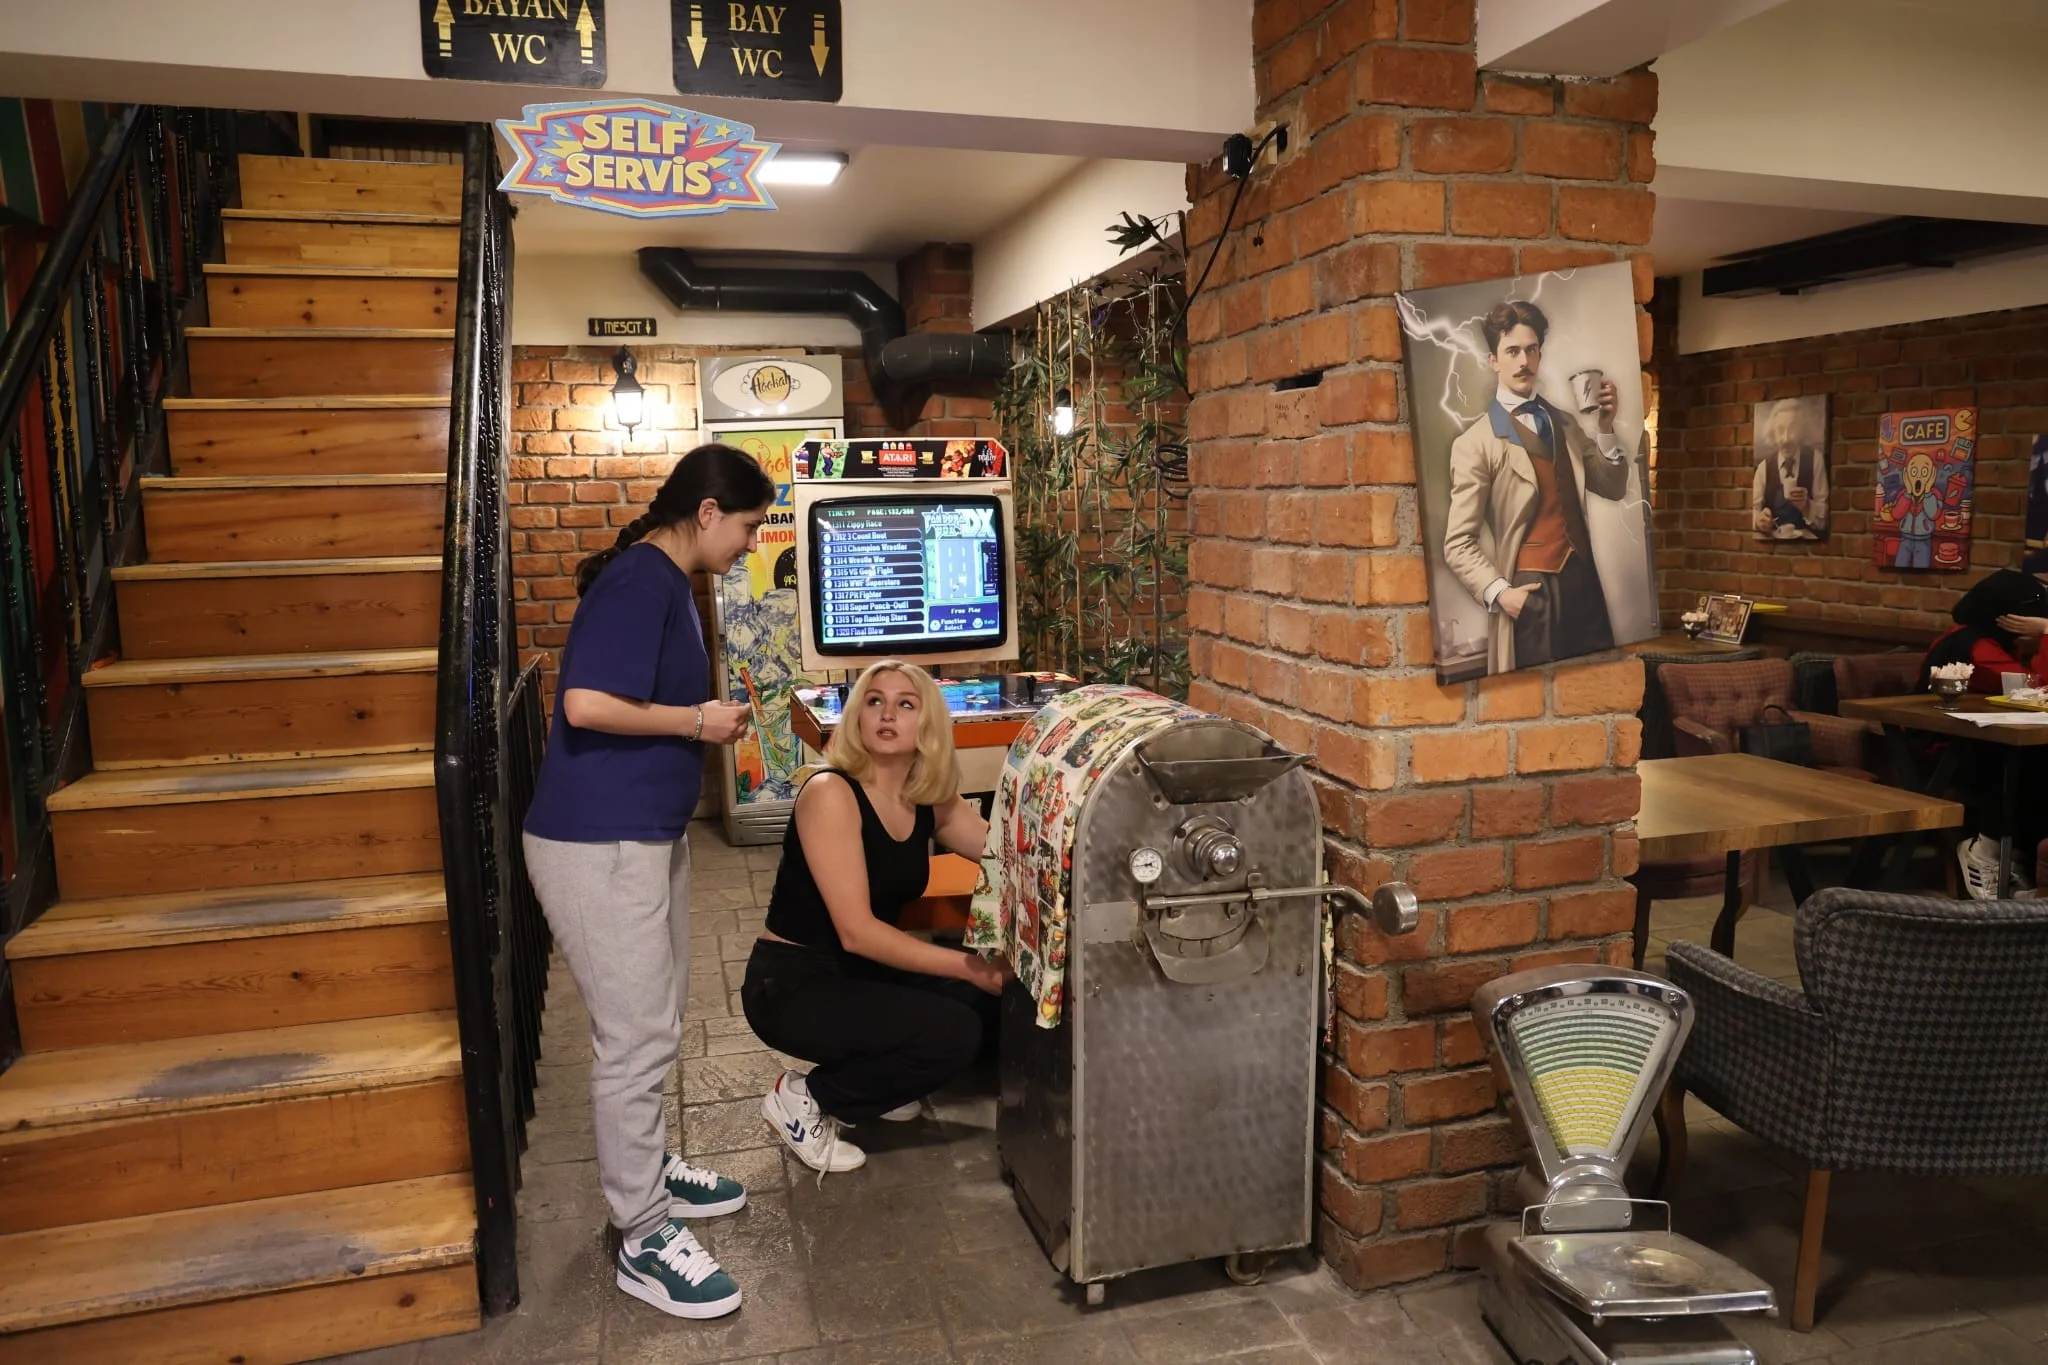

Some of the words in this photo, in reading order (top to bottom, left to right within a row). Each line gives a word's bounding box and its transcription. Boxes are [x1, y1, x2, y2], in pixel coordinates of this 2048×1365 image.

[463, 0, 568, 20] BAYAN
[728, 3, 787, 34] BAY
[489, 33, 547, 64] WC
[731, 47, 783, 78] WC
[582, 114, 688, 154] SELF
[1904, 422, 1945, 440] CAFE
[883, 454, 912, 462] ATARI
[761, 513, 796, 524] ABAN
[954, 508, 996, 537] DX
